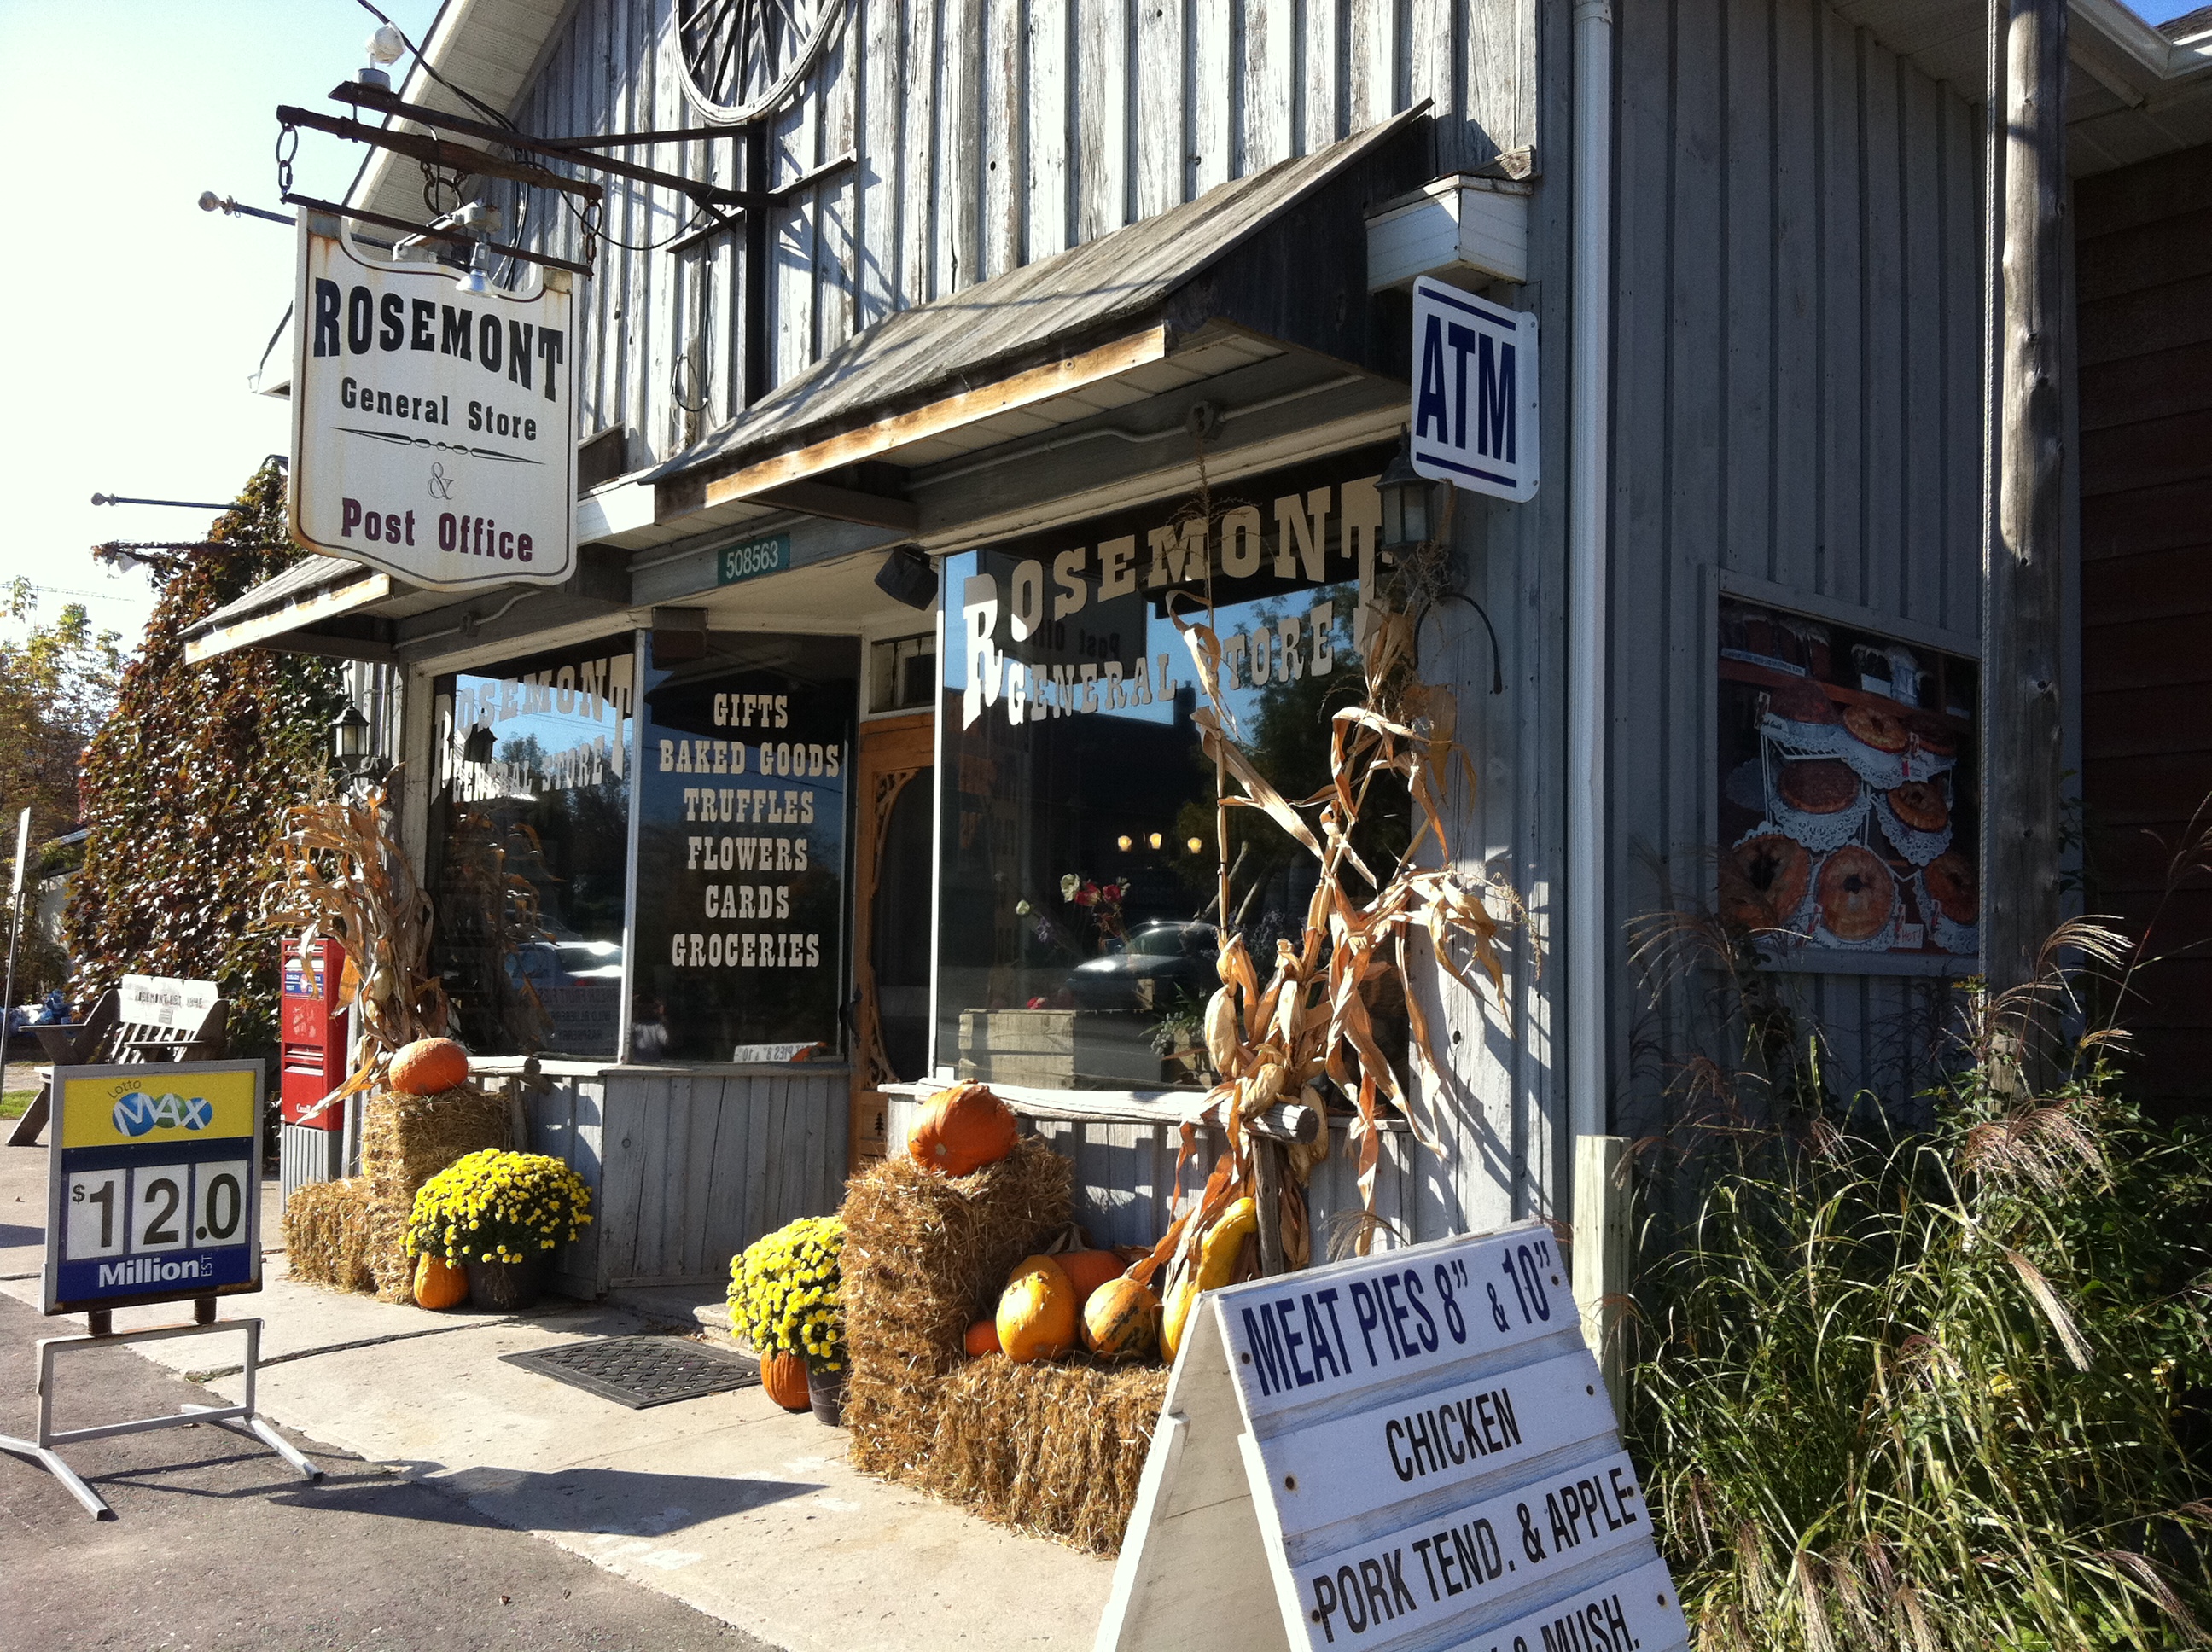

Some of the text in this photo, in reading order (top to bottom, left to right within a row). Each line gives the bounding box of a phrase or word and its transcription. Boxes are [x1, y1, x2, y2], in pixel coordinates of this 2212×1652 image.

[313, 277, 563, 402] ROSEMONT
[341, 376, 536, 440] General Store
[1416, 312, 1516, 464] ATM
[428, 462, 455, 500] &
[341, 497, 533, 562] Post Office
[725, 540, 779, 579] 508563
[963, 474, 1393, 731] ROSEMONT
[1008, 602, 1334, 726] GENERAL TORE
[430, 653, 634, 806] ROSEMONT
[713, 693, 788, 728] GIFTS
[453, 735, 605, 803] GENERAL STORE
[659, 739, 840, 777] BAKED GOODS
[684, 788, 815, 824] TRUFFLES
[687, 836, 808, 871] FLOWERS
[706, 885, 789, 919] CARDS
[672, 934, 820, 968] GROCERIES
[107, 1079, 142, 1099] Lotto
[113, 1091, 208, 1137] MAX
[98, 1251, 212, 1288] Million EST.
[1241, 1287, 1353, 1397] MEAT
[1349, 1268, 1440, 1367] PIES
[1486, 1281, 1511, 1333] &
[1385, 1387, 1522, 1483] CHICKEN
[1313, 1466, 1638, 1643] PORK TEND. & APPLE
